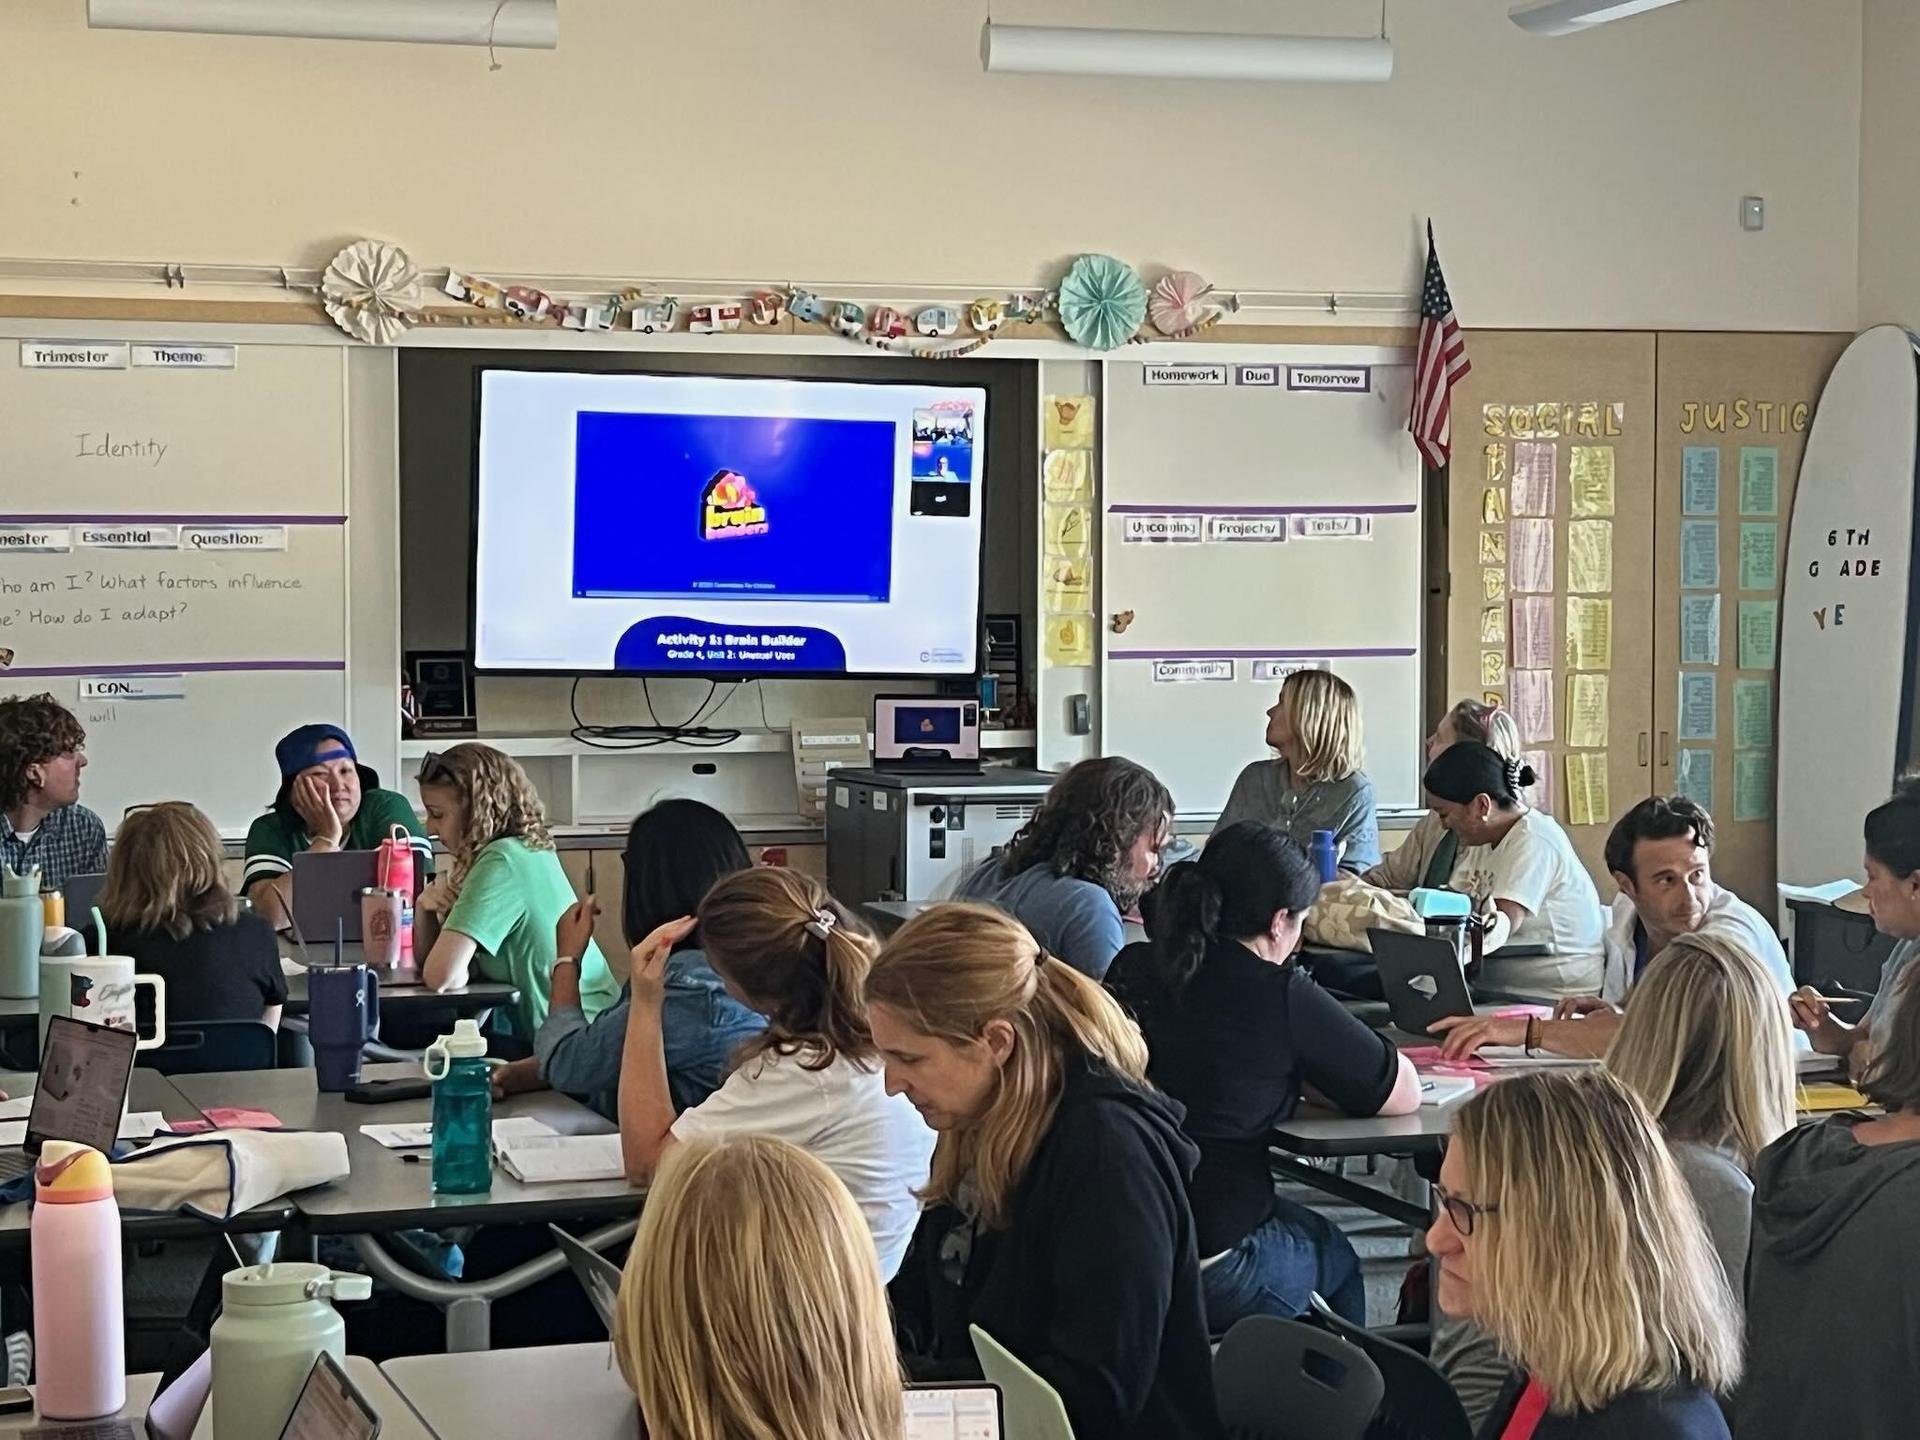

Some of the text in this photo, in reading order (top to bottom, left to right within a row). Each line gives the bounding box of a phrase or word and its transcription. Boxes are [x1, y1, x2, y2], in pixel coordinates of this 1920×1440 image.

[35, 350, 109, 363] Trimester
[1151, 369, 1360, 385] Homework Due Tomorrow
[1484, 399, 1809, 438] SOCIAL JUSTIC
[75, 432, 168, 467] Identity
[82, 530, 151, 543] Essential
[0, 570, 303, 594] ho am I? What factors influence
[30, 607, 65, 624] How
[73, 607, 92, 624] do
[100, 607, 111, 620] I
[122, 602, 188, 622] adapt?
[657, 634, 706, 647] Activity
[725, 634, 758, 646] Brain
[761, 634, 807, 647] Builder
[667, 650, 694, 659] Grade
